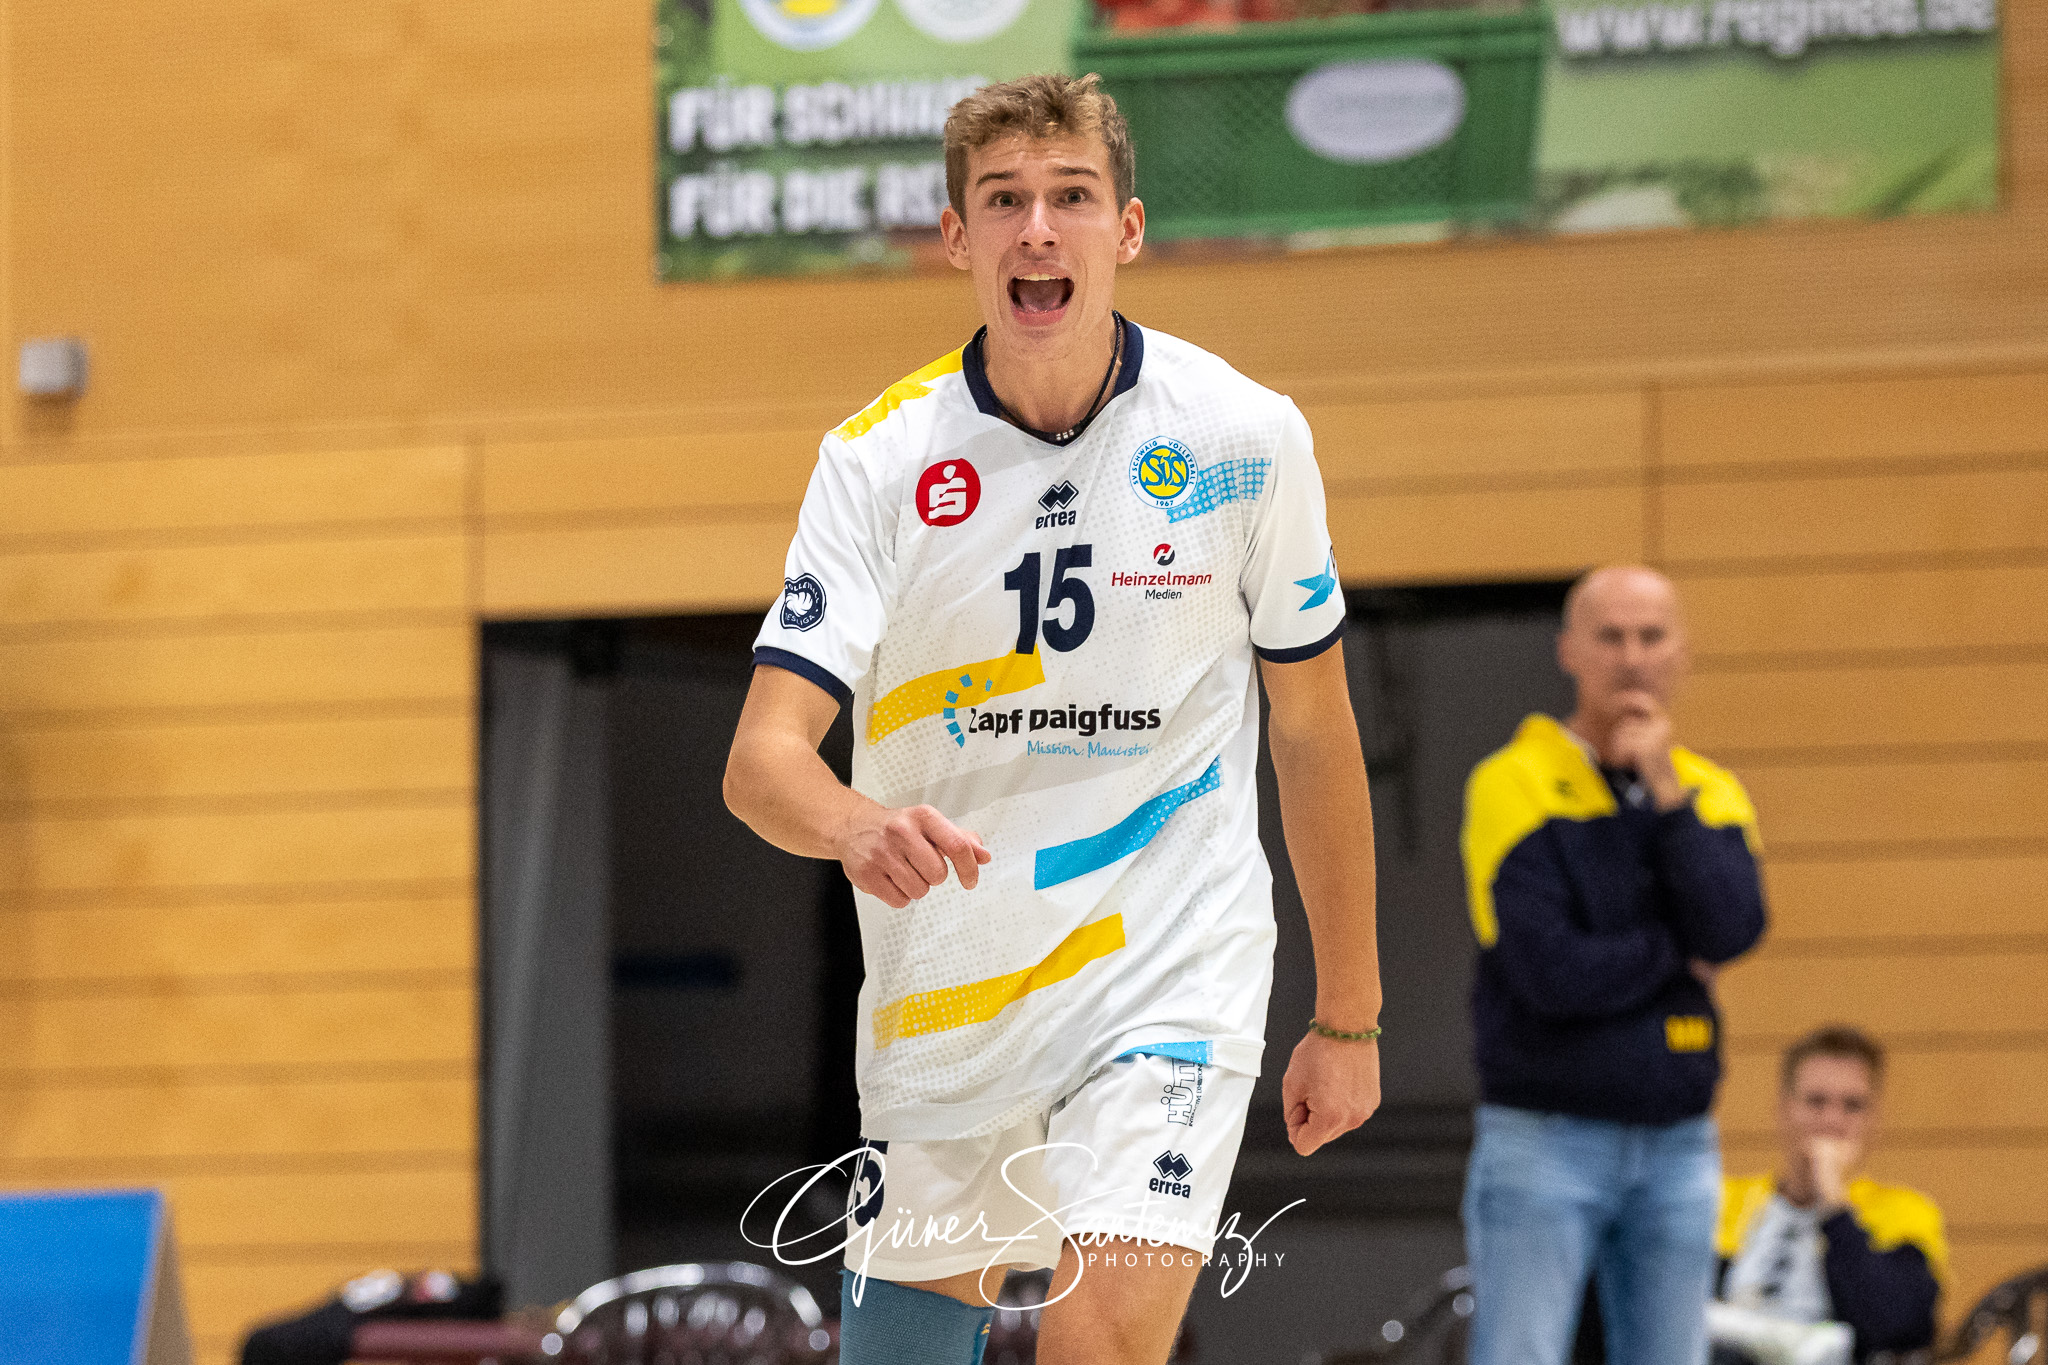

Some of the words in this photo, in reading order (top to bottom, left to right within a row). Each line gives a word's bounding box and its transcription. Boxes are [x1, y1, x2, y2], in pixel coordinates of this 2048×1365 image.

[1132, 441, 1158, 472] SCHWAIG
[1168, 441, 1196, 485] VOLLEYBALL
[1036, 510, 1077, 529] errea
[1111, 571, 1212, 587] Heinzelmann
[1004, 544, 1095, 655] 15
[1145, 589, 1182, 600] Medien
[1029, 703, 1162, 737] Daigfuss
[1149, 1177, 1191, 1199] errea
